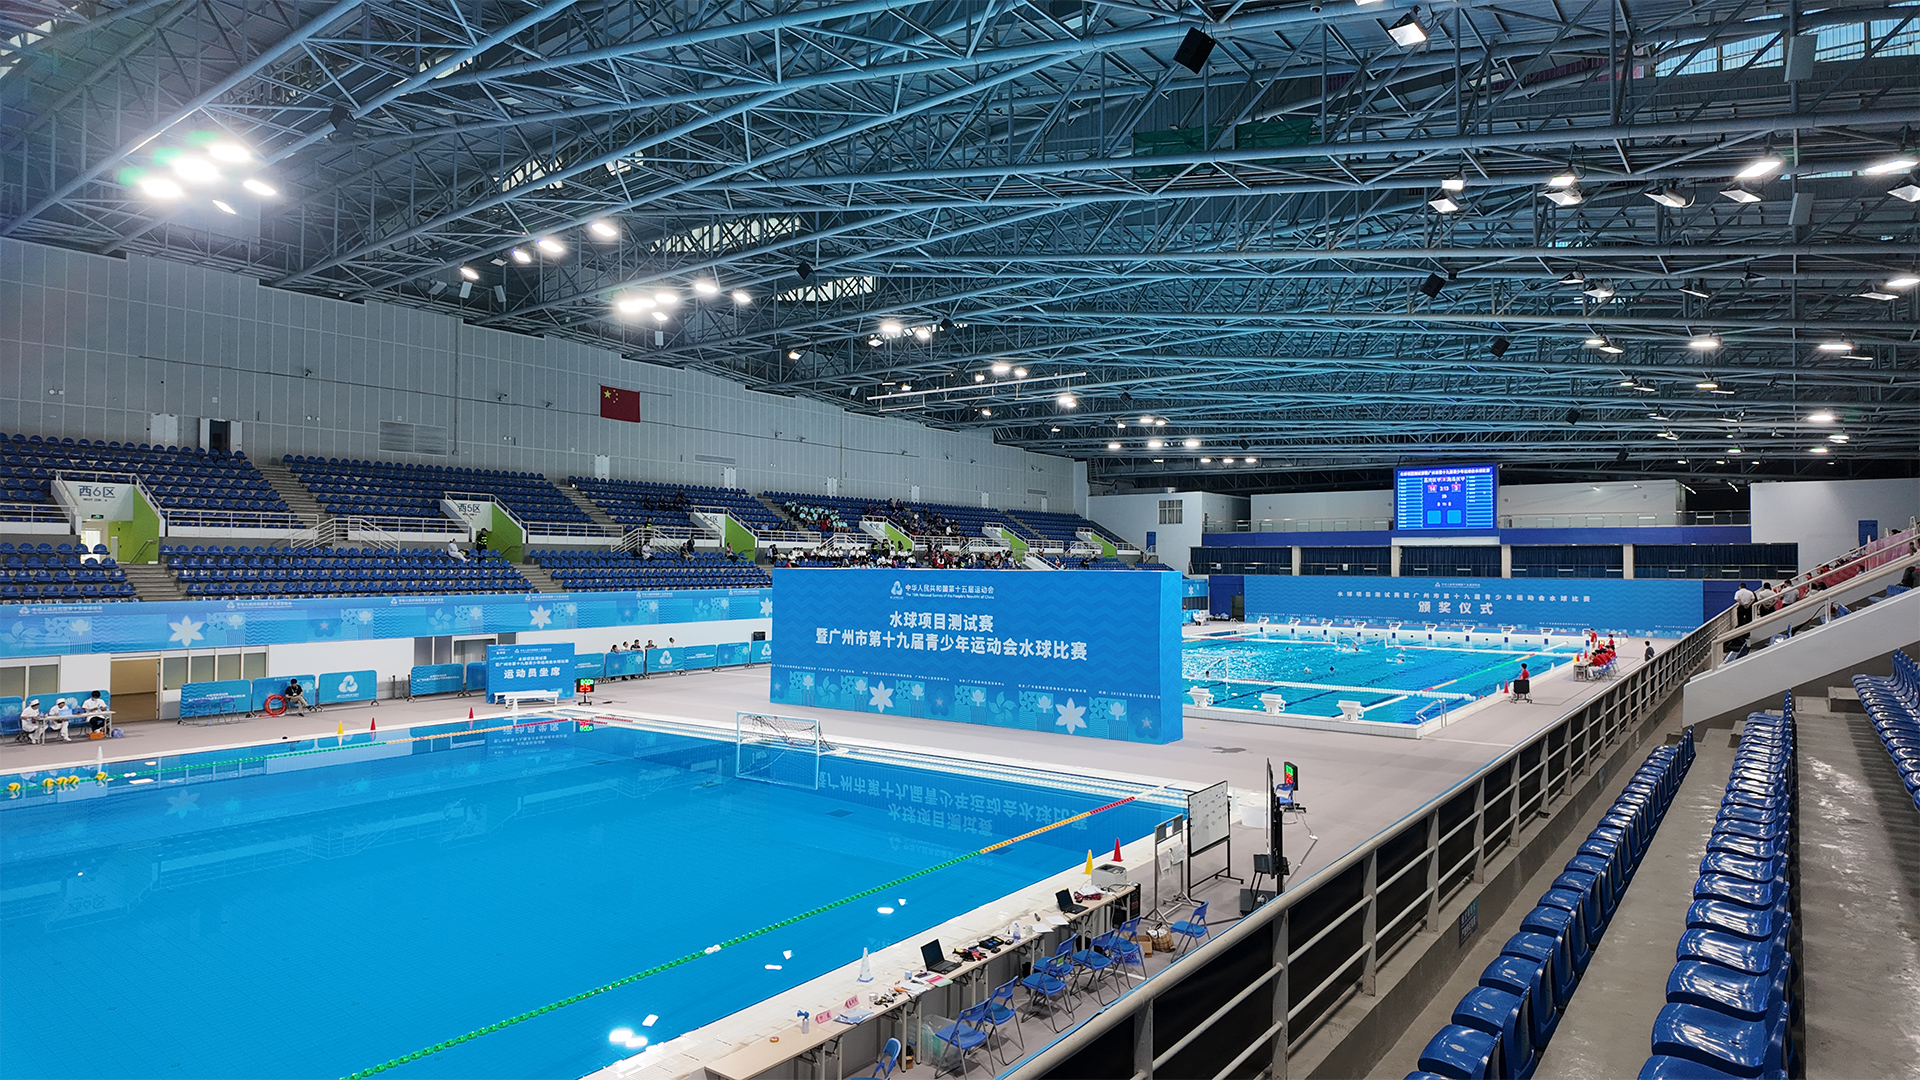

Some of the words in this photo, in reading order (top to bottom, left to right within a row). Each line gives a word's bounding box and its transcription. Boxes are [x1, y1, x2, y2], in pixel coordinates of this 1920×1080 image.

[78, 485, 116, 498] 西6区
[458, 503, 481, 513] 西5区
[905, 584, 994, 594] 中华人民共和国第十五届运动会
[1418, 601, 1493, 615] 颁奖仪式
[889, 610, 994, 633] 水球项目测试赛
[816, 627, 1087, 661] 暨广州市第十九届青少年运动会水球比赛
[503, 667, 561, 679] 运动员坐席
[579, 684, 591, 692] 25
